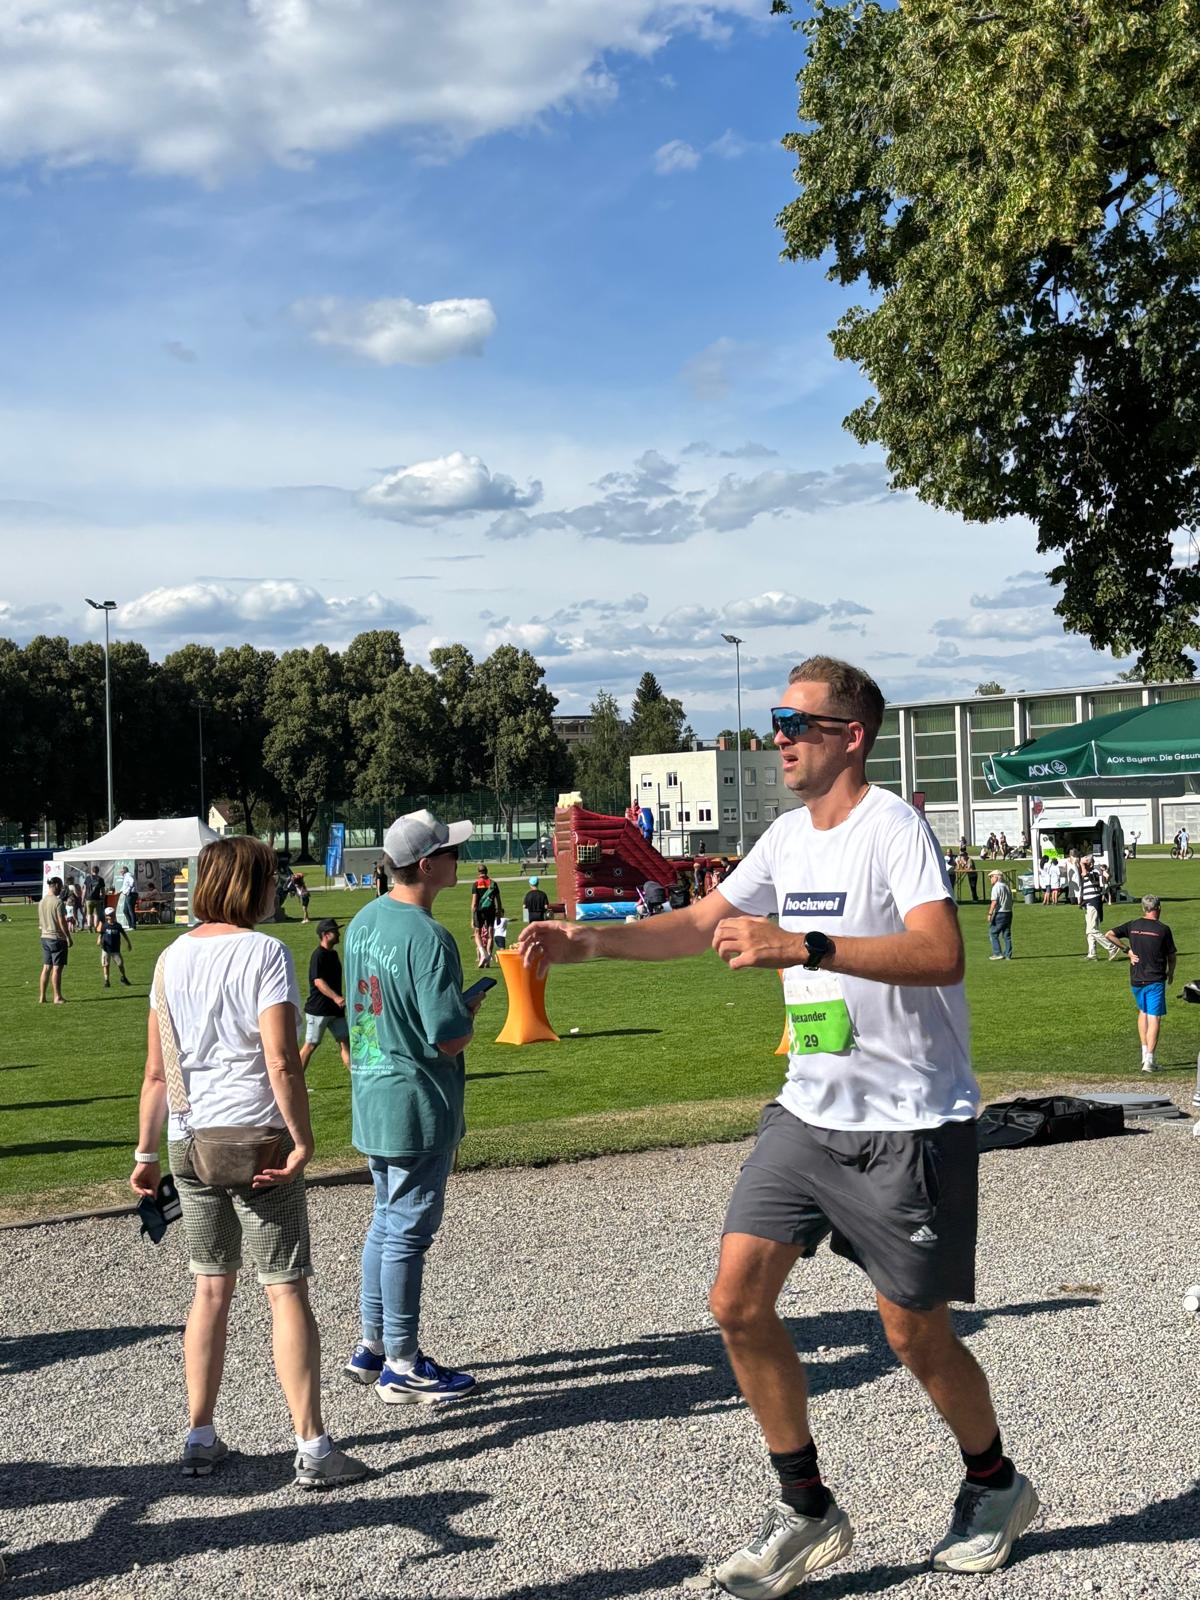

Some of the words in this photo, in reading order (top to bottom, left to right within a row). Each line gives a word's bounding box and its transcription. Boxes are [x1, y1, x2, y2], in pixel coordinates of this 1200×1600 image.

[1106, 756, 1125, 764] AOK
[1126, 755, 1158, 764] Bayern.
[1159, 753, 1173, 762] Die
[1028, 763, 1055, 778] AOK
[785, 896, 840, 911] hochzwei
[803, 1033, 819, 1048] 29
